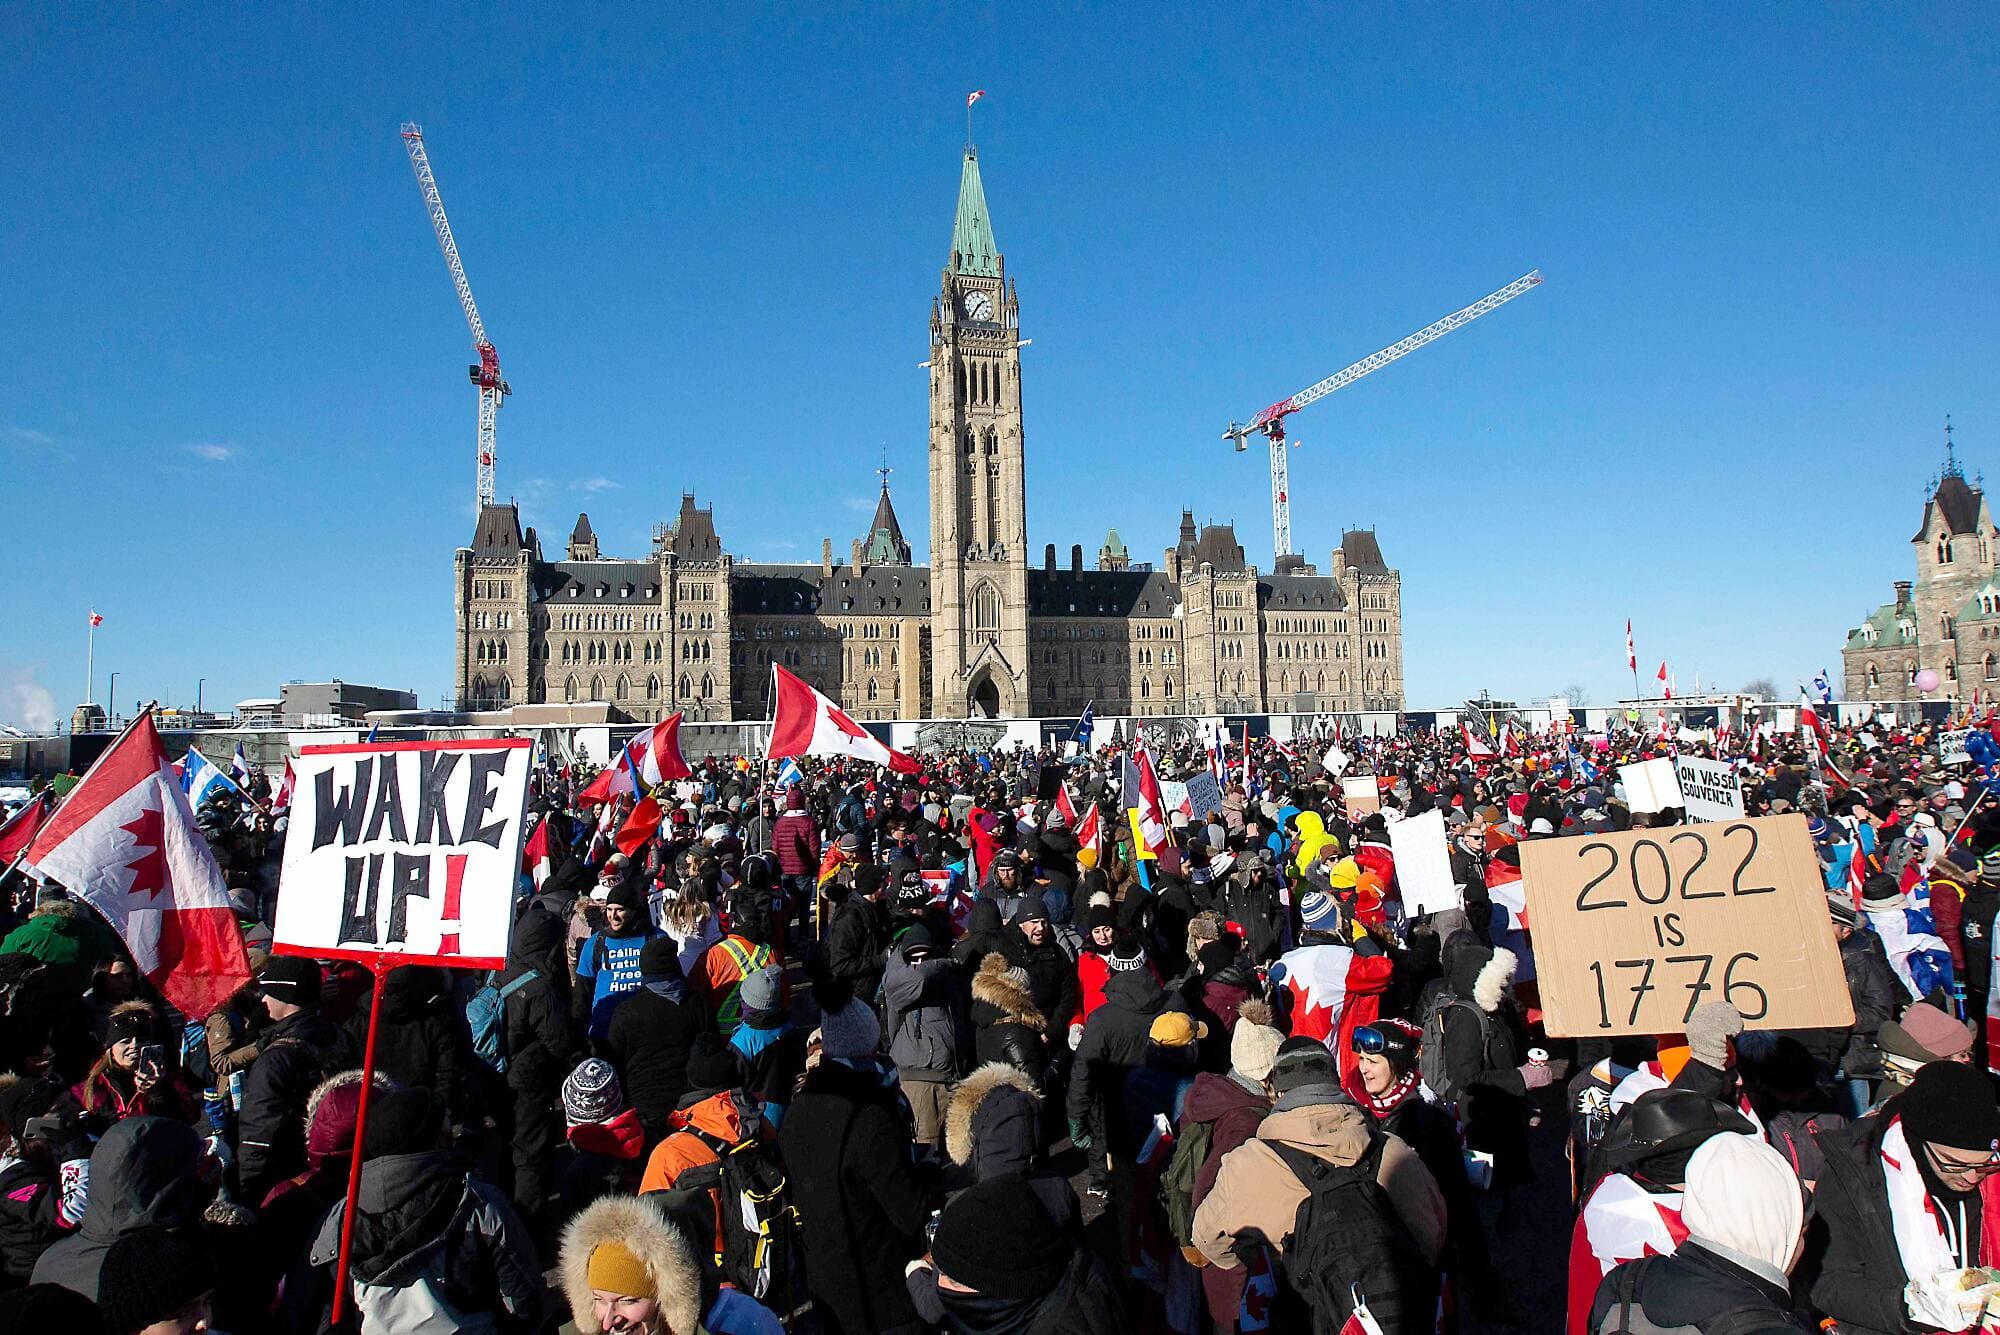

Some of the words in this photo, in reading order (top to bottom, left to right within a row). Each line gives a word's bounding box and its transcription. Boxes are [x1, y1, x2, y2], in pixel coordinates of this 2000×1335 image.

[311, 748, 511, 853] WAKE
[1681, 766, 1696, 783] ON
[1684, 782, 1733, 808] SOUVENIR
[1577, 823, 1777, 911] 2022
[337, 850, 469, 955] UP!
[1653, 913, 1685, 947] IS
[613, 970, 642, 980] Free
[1589, 951, 1769, 1029] 1776
